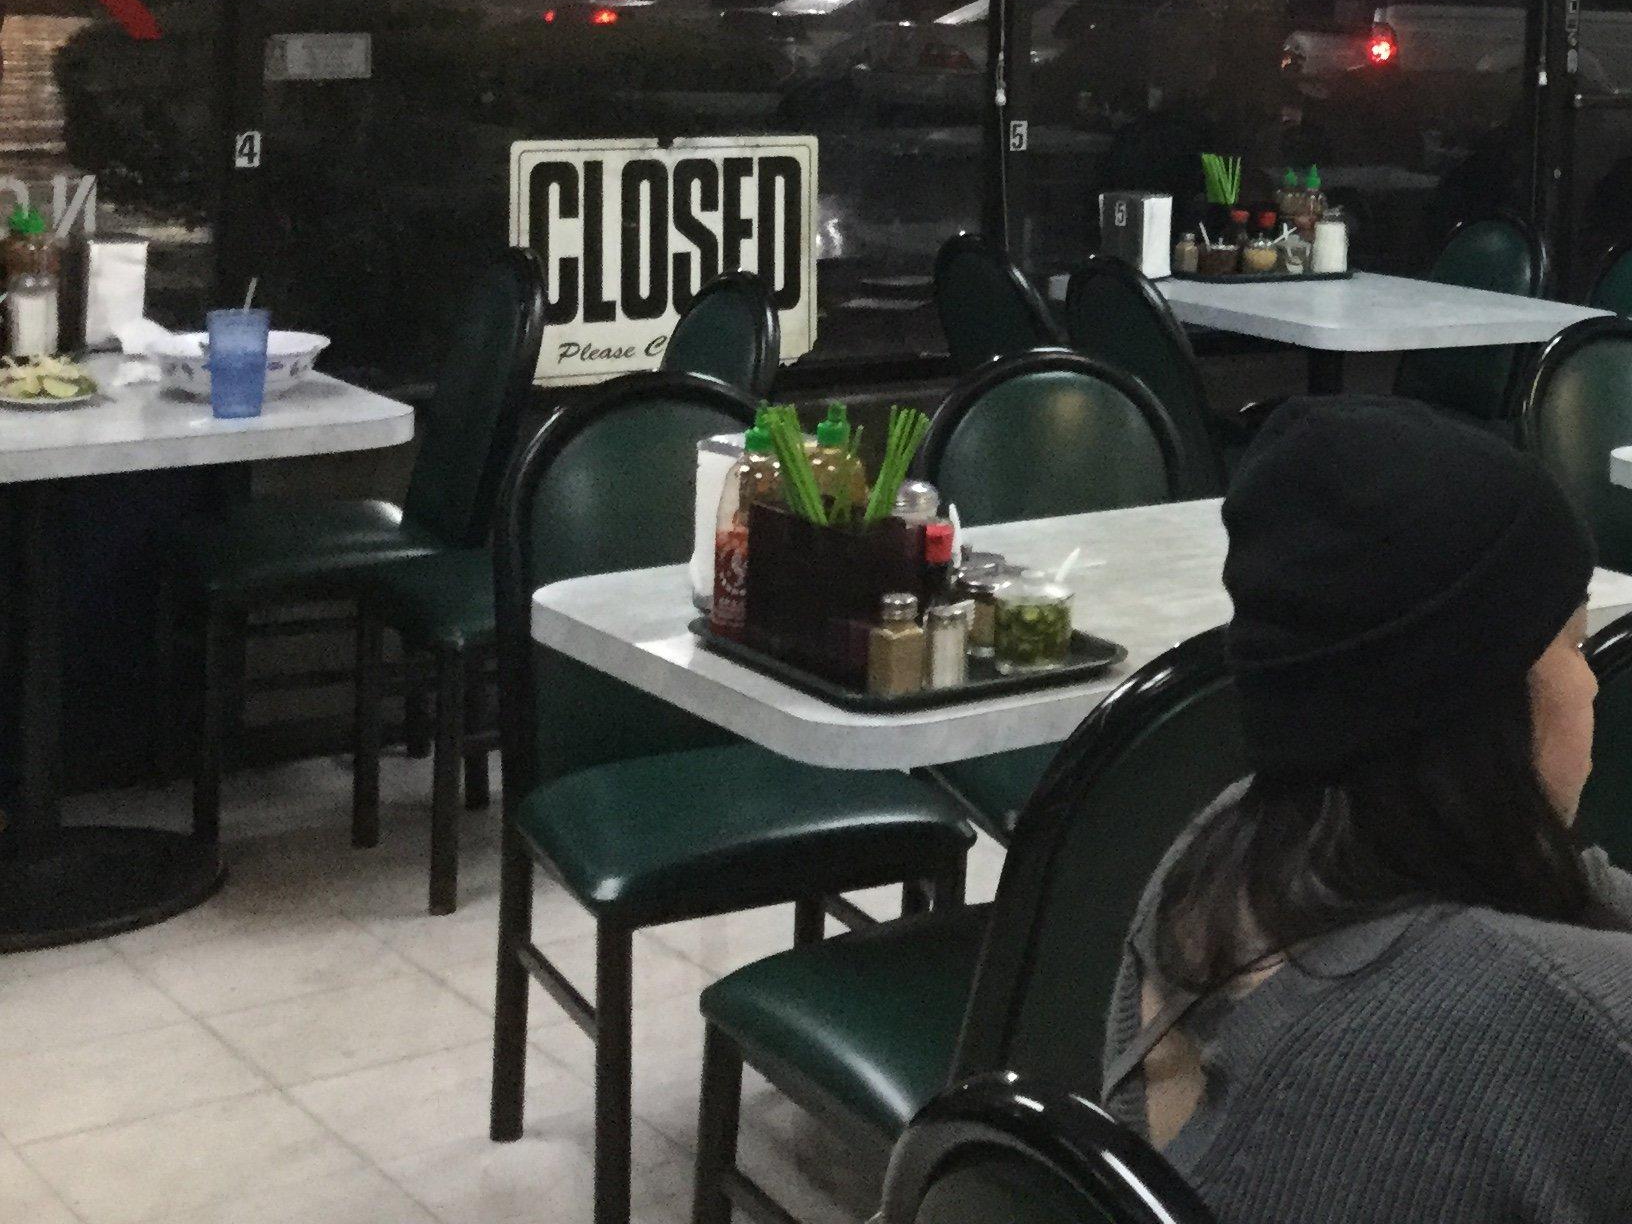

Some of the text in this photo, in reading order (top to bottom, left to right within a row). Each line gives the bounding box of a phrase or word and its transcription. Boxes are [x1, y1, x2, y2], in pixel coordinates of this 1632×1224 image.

[237, 135, 258, 165] 4
[1010, 123, 1025, 149] 5
[528, 155, 802, 326] CLOSED
[556, 341, 636, 364] Please
